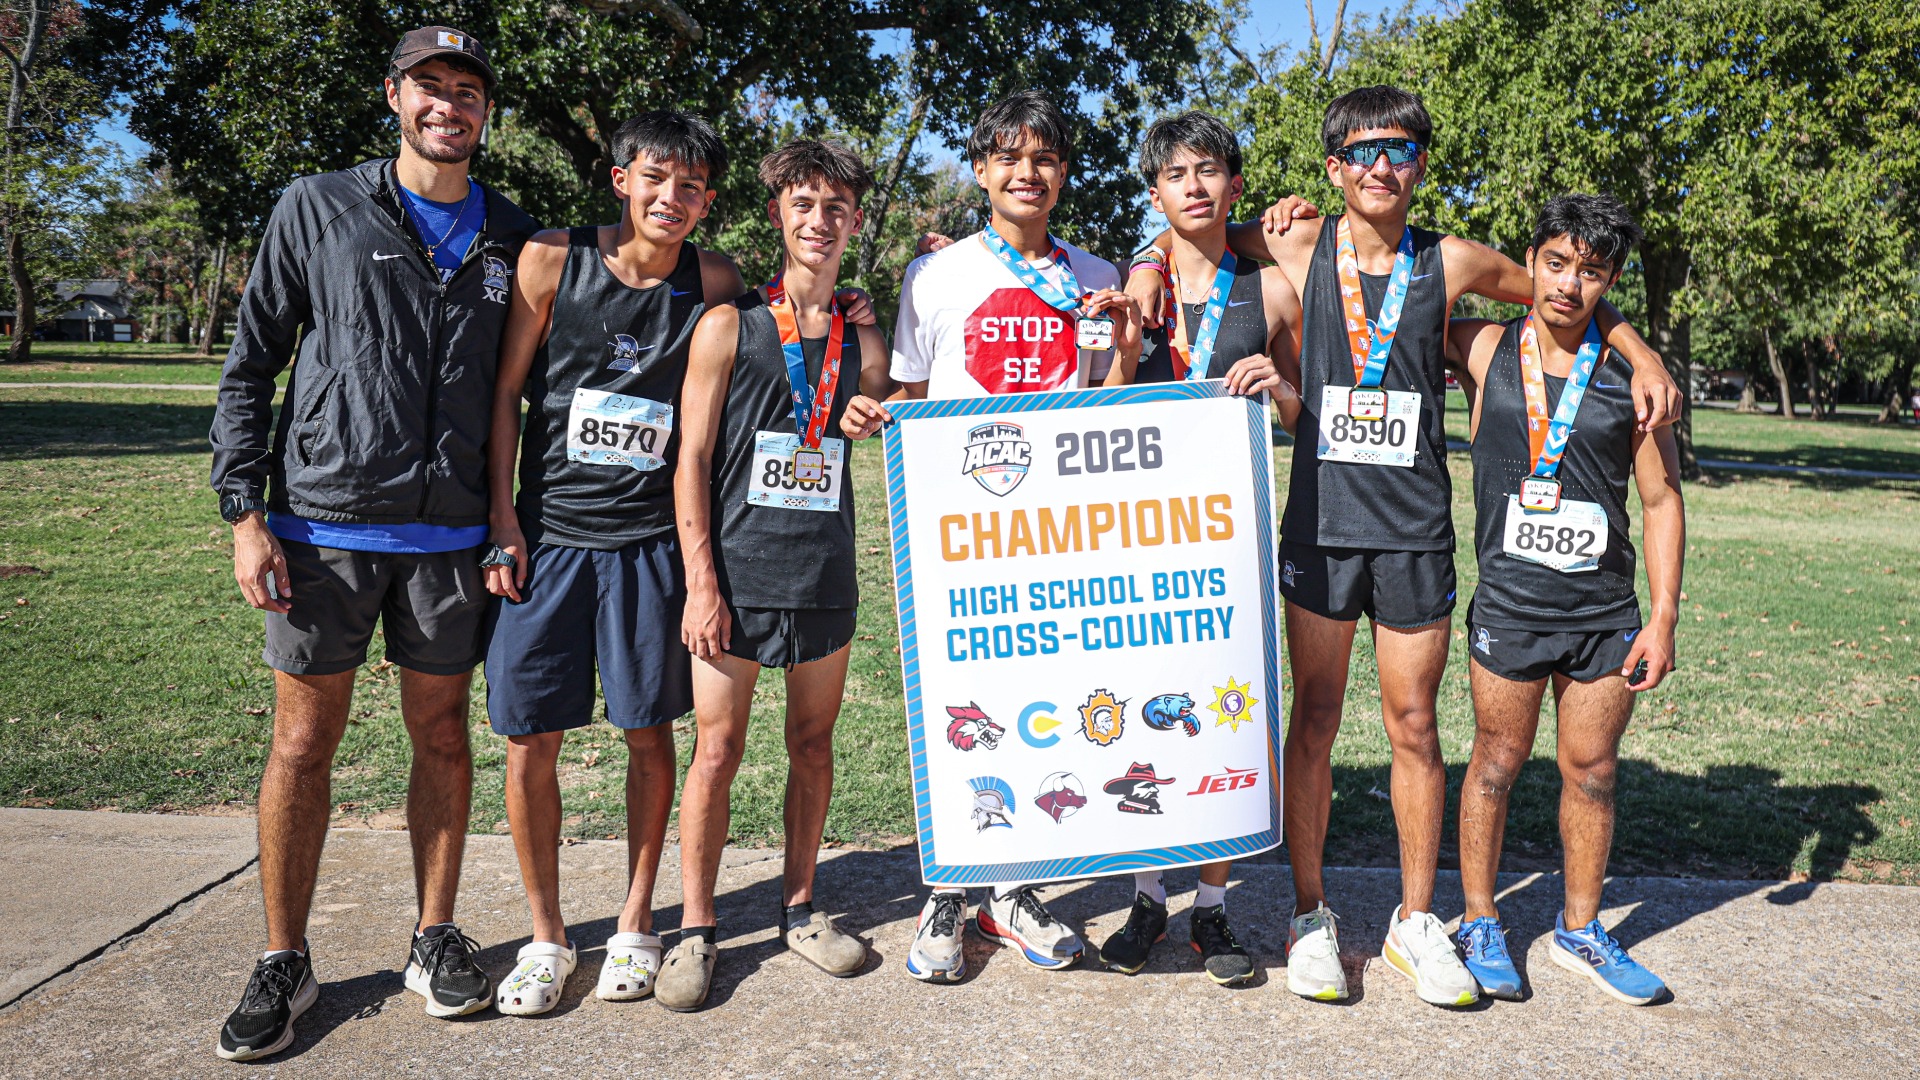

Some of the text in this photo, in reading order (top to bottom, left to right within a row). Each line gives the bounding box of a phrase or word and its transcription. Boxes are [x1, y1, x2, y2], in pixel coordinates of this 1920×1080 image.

[482, 286, 507, 304] XC
[981, 316, 1063, 342] STOP
[1003, 357, 1041, 383] SE
[580, 418, 657, 453] 8570
[1330, 414, 1406, 447] 8590
[962, 441, 1032, 475] ACAC
[1056, 426, 1163, 476] 2026
[939, 493, 1235, 562] CHAMPIONS
[1515, 522, 1595, 557] 8582
[949, 567, 1226, 617] HIGH SCHOOL BOYS
[946, 605, 1234, 662] CROSS-COUNTRY
[1187, 771, 1259, 796] JETS
